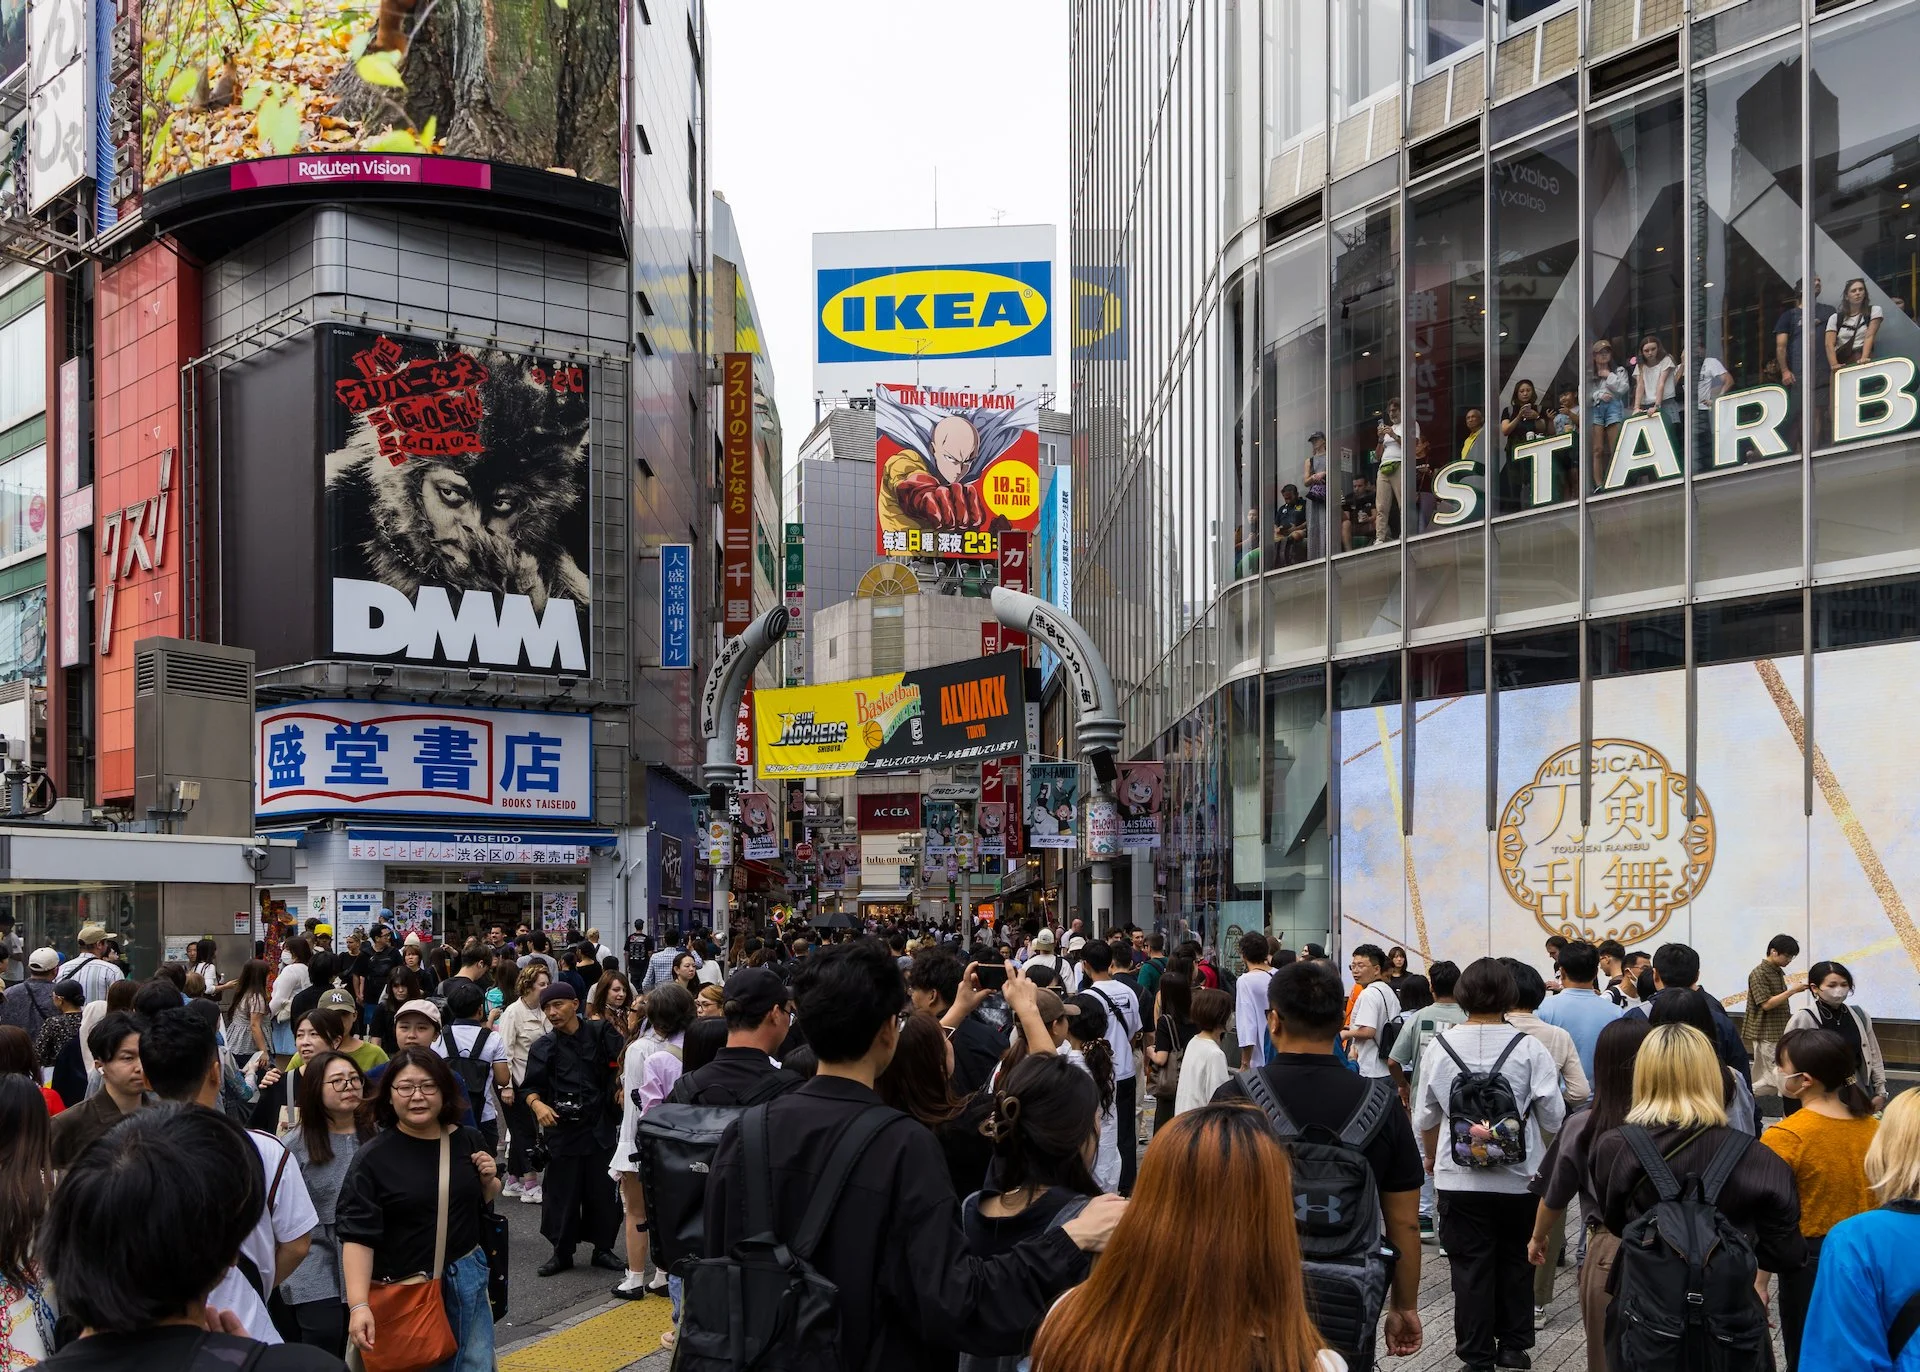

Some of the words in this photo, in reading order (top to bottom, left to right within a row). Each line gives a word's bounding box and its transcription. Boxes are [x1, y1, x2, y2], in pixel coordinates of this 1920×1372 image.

[299, 160, 360, 180] Rakuten
[363, 160, 411, 175] Vision
[842, 290, 1033, 332] IKEA
[900, 390, 926, 405] ONE
[931, 392, 978, 409] PUNCH
[982, 395, 1015, 410] MAN
[729, 361, 748, 514] クスリのことなら
[1432, 356, 1919, 526] STARB
[993, 476, 1025, 493] 10.5
[994, 494, 1008, 505] ON
[1012, 495, 1031, 506] AIR
[883, 530, 934, 552] 毎週日曜
[938, 532, 962, 553] 深夜
[726, 528, 750, 622] 三千里
[333, 577, 587, 671] DMM
[667, 552, 685, 661] 大盛堂商事ビル
[1035, 613, 1093, 705] 渋谷センター街
[703, 640, 740, 735] 渋谷センター街
[855, 684, 920, 724] Basketball
[940, 675, 1009, 726] ALVARK
[769, 712, 848, 747] ROCKERS
[795, 711, 815, 725] SUN
[965, 724, 987, 740] TOKYO
[267, 724, 563, 794] 盛堂書店
[817, 744, 841, 753] SHIBUYA
[502, 798, 532, 809] BOOKS
[536, 799, 576, 810] TAISEIDO
[1533, 774, 1671, 846] 刀剣
[352, 845, 575, 864] まるごとぜんぶ渋谷区の本発売中
[454, 834, 522, 844] TAISEIDO
[1551, 846, 1601, 855] TOUKEN
[1605, 843, 1650, 853] RANBU
[1532, 855, 1673, 923] 乱舞
